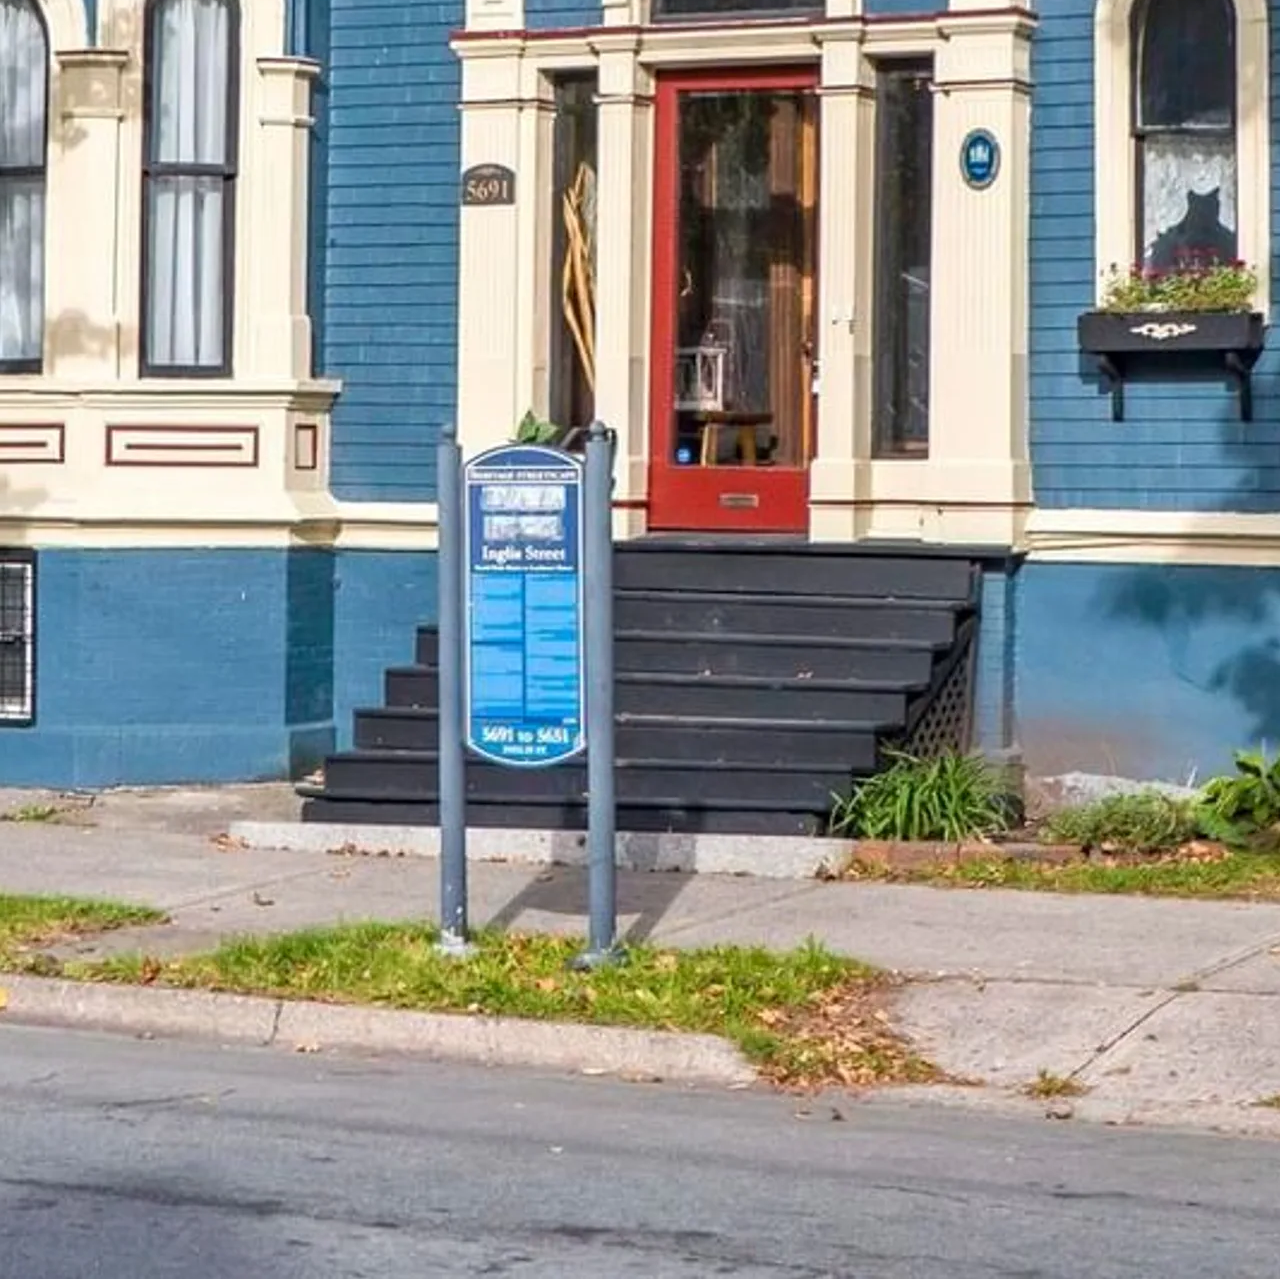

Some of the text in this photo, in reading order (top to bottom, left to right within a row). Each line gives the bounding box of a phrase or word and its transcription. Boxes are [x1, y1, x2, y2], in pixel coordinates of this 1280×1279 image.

[467, 180, 508, 201] 5691
[482, 545, 565, 564] Inglis Street
[518, 727, 534, 742] to
